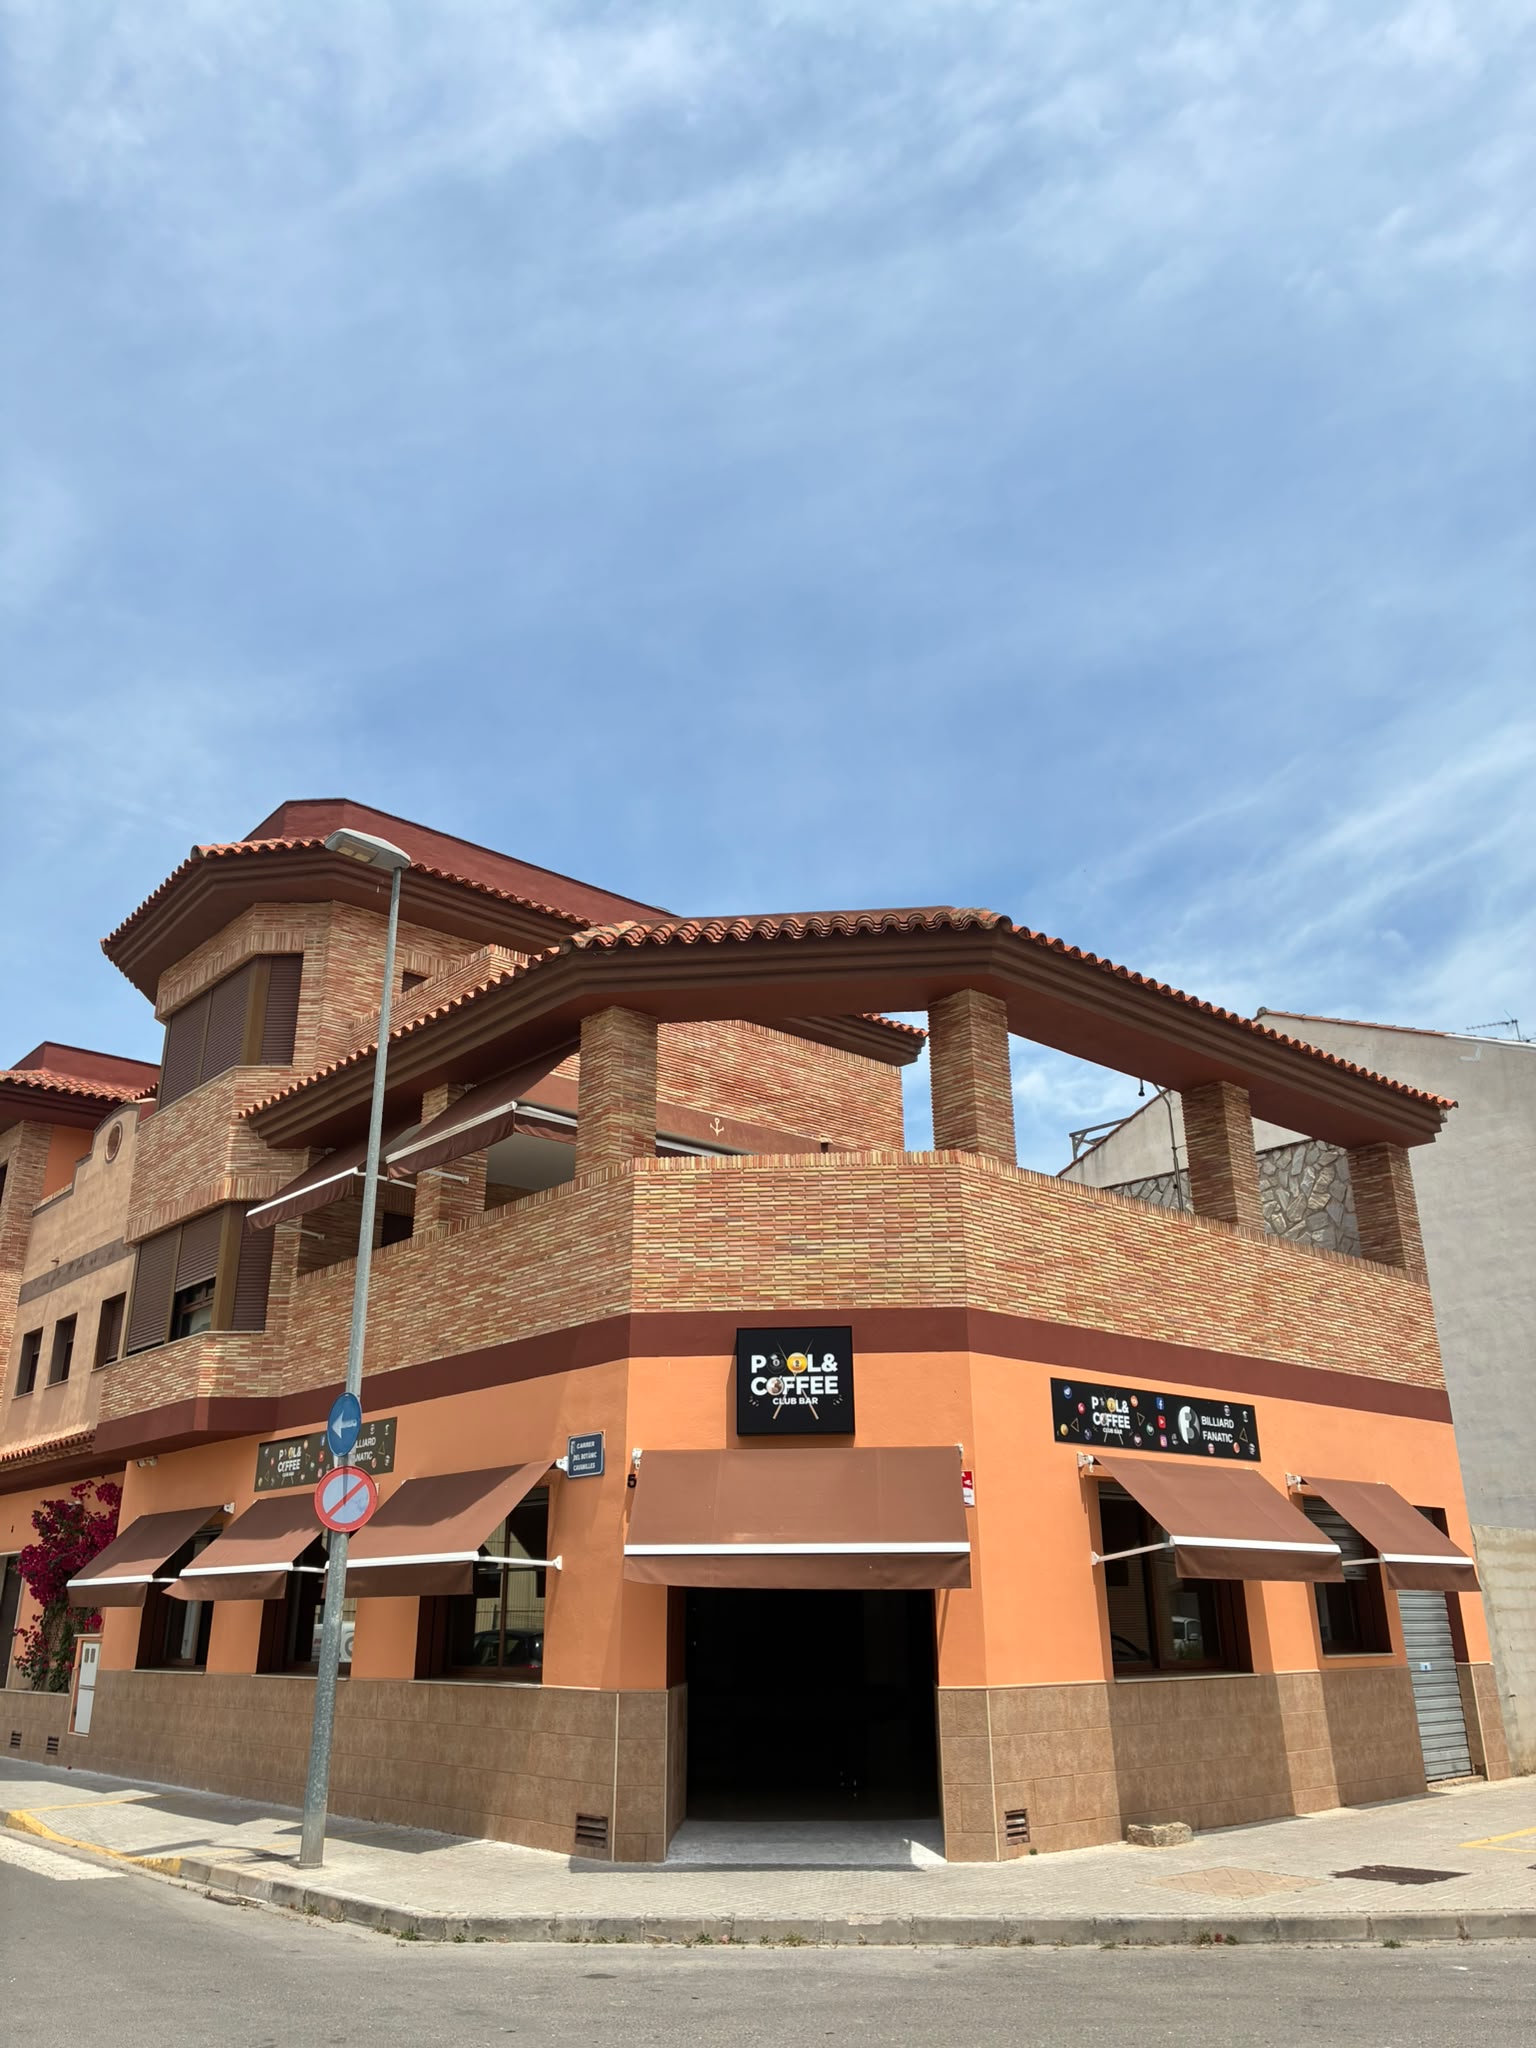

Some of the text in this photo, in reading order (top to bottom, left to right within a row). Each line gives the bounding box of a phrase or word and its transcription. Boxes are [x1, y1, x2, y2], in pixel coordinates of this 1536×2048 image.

[751, 1375, 839, 1396] COFFEE
[772, 1397, 818, 1405] CLUB BAR
[1092, 1412, 1131, 1429] COFFEE
[1201, 1416, 1234, 1429] BILLIARD
[355, 1437, 376, 1448] LLIARD
[1202, 1430, 1234, 1443] FANATIC
[355, 1450, 373, 1462] NATIC
